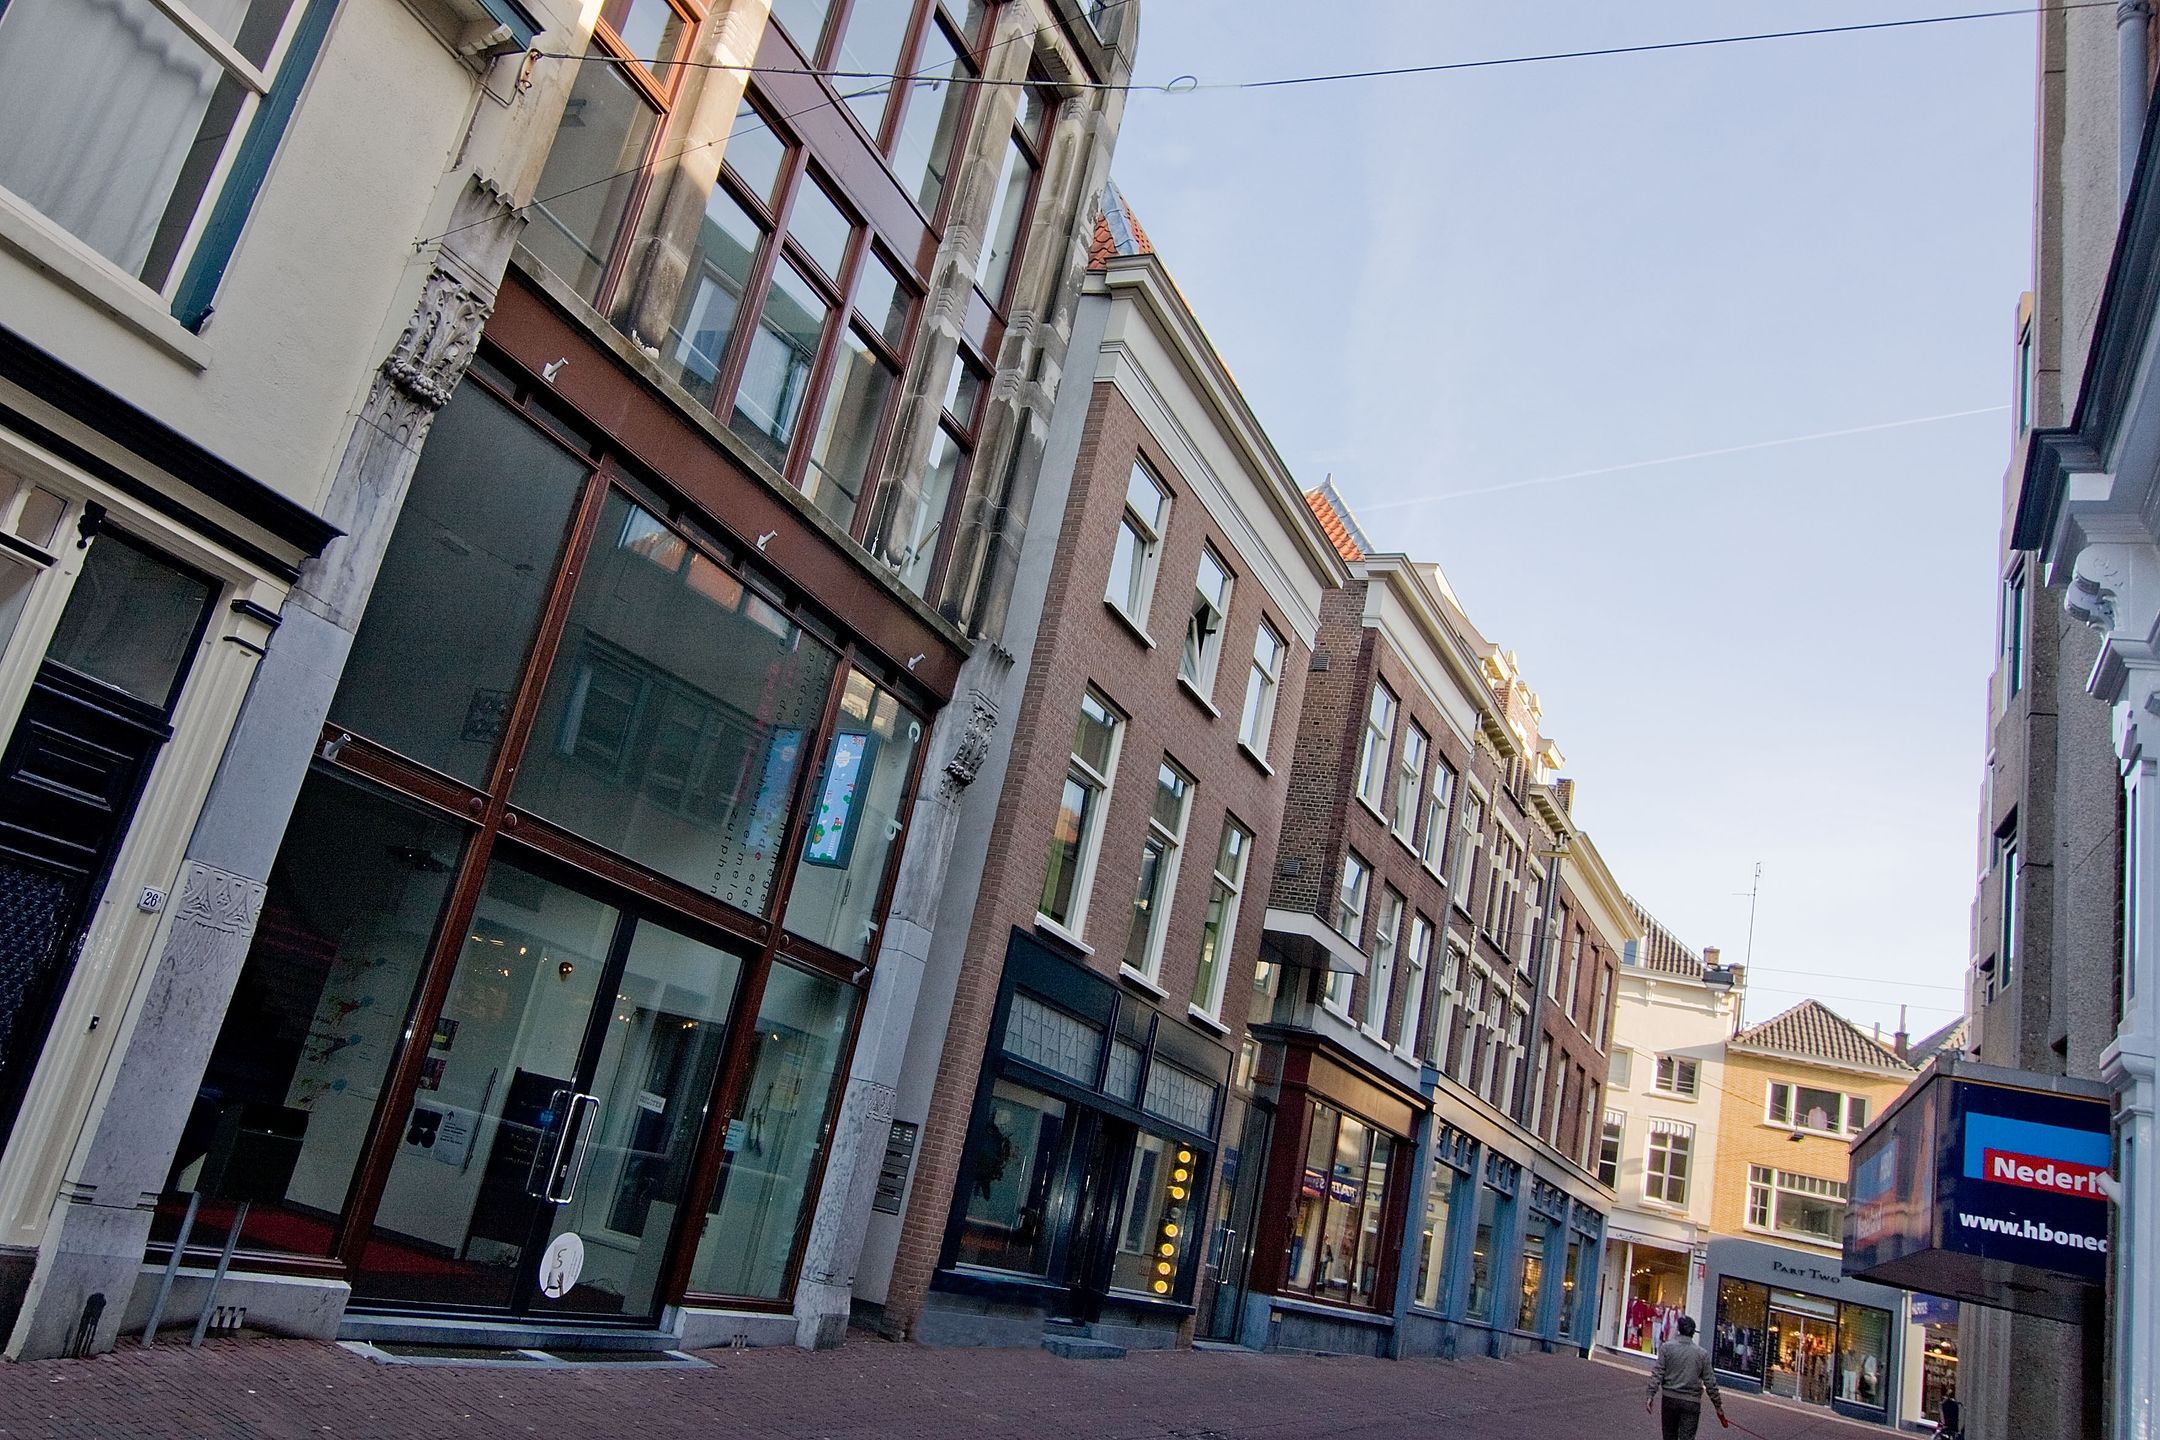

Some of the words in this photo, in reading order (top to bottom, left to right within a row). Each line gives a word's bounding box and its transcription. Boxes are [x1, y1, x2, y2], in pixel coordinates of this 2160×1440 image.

[710, 808, 738, 895] zutphen
[726, 829, 750, 901] ermelo
[741, 873, 756, 908] ede
